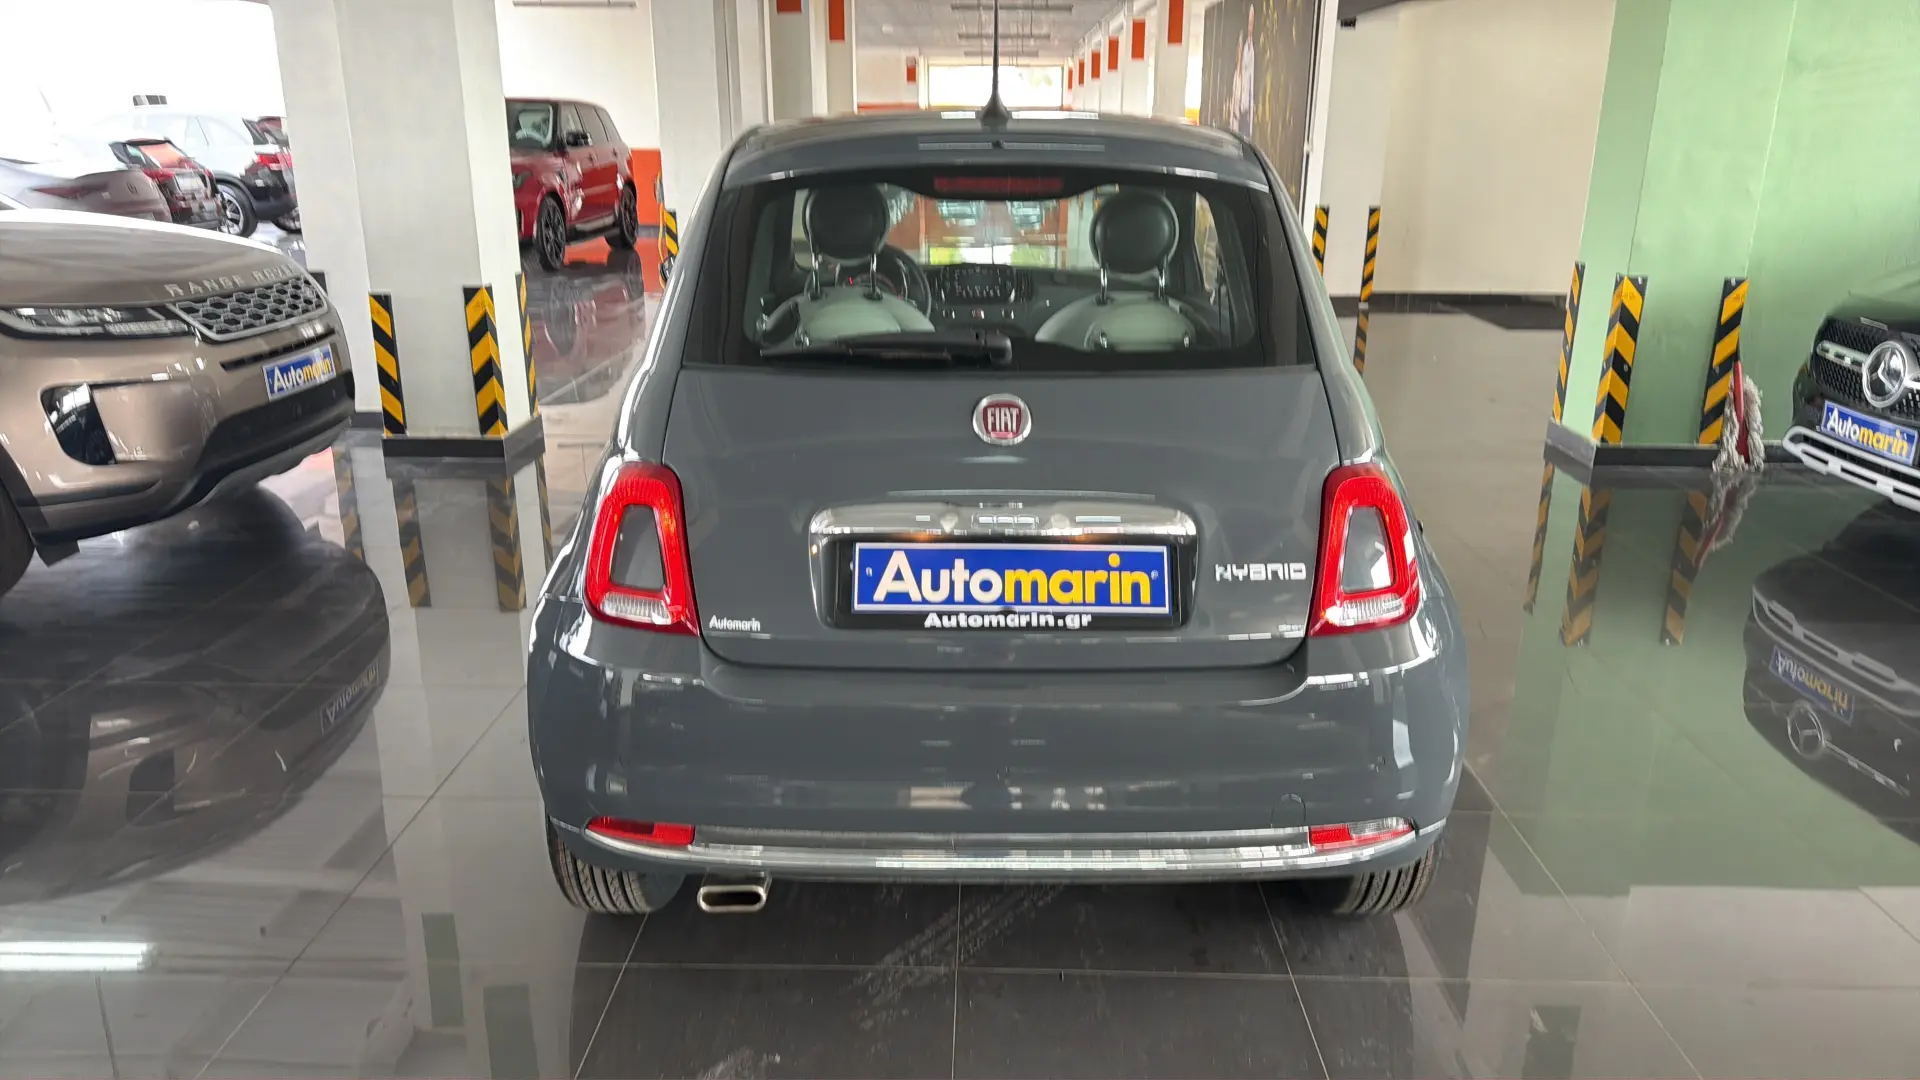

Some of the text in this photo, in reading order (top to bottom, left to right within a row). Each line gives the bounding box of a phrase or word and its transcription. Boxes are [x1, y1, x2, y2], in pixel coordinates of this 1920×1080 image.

[164, 275, 245, 297] RANGE
[272, 355, 332, 393] Automarin
[986, 407, 1020, 433] FIAT
[1826, 406, 1909, 457] Automarin
[873, 550, 1151, 604] Automarin
[709, 615, 761, 631] Automarin
[924, 612, 1092, 629] Automarin.gr
